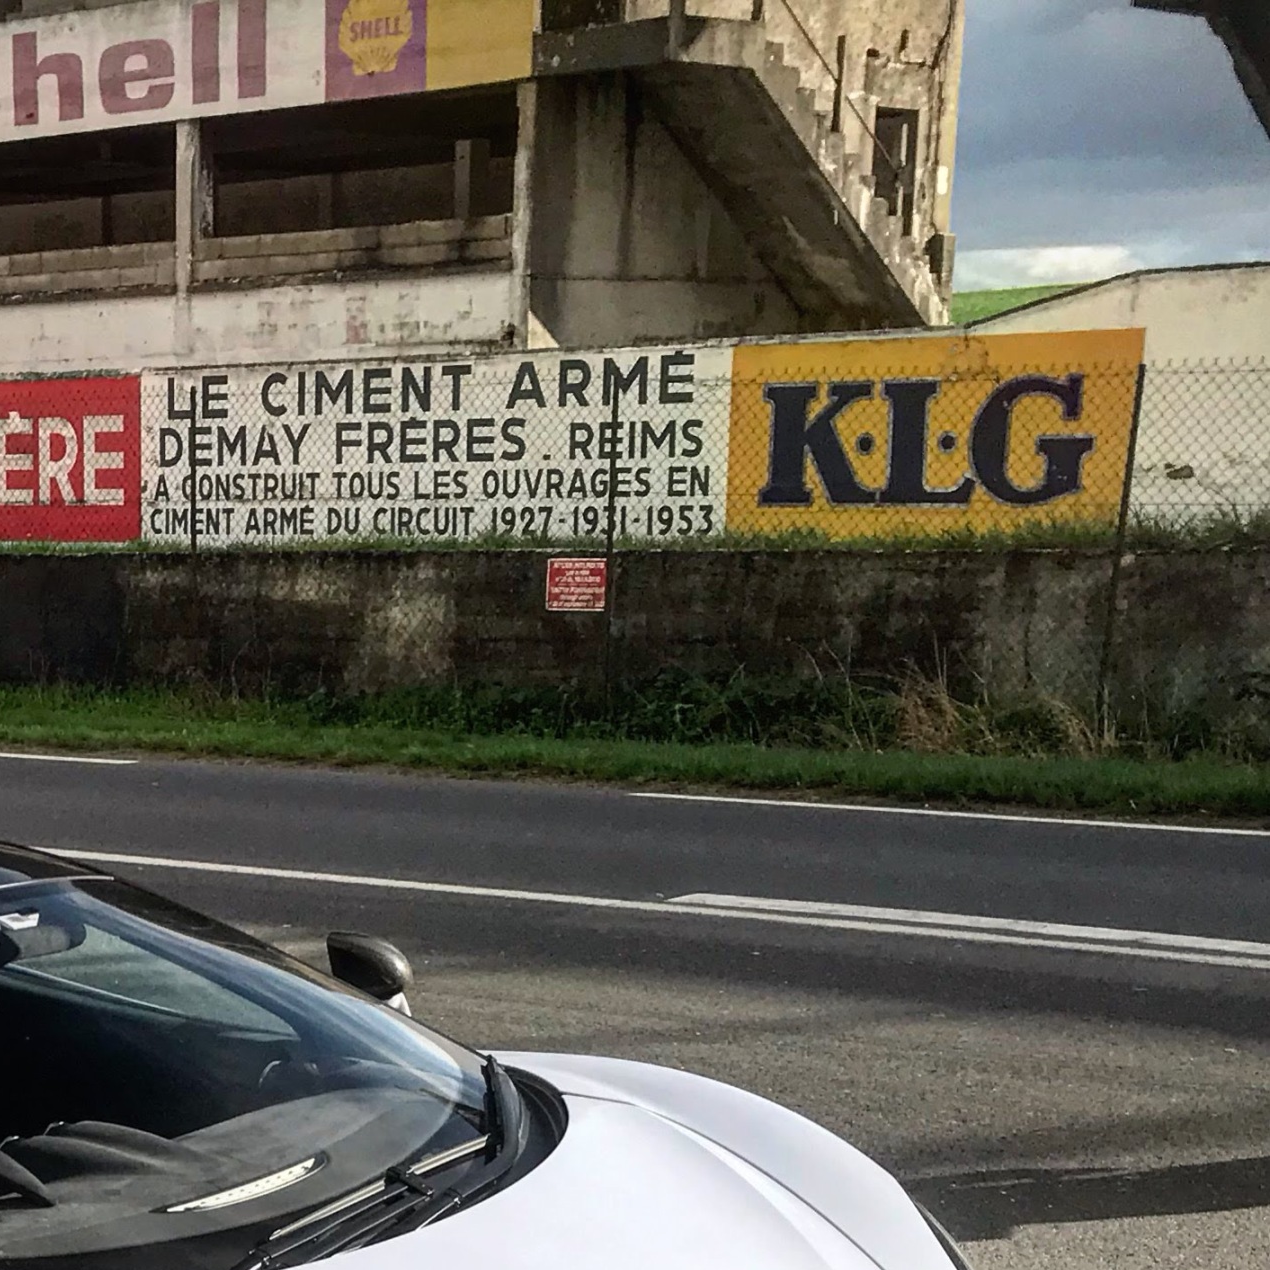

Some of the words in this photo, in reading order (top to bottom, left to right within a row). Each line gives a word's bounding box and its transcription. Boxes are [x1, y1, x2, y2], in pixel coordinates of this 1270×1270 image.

[349, 15, 404, 43] SHELL
[167, 374, 229, 420] LE
[260, 364, 472, 418] CIMENT
[505, 350, 696, 409] ARMÉ
[158, 422, 312, 468] DEMAY
[569, 419, 703, 460] REIMS
[154, 474, 170, 501] A
[181, 472, 320, 500] CONSTRUIT
[332, 471, 400, 500] TOUS
[414, 470, 468, 499] LES
[482, 466, 652, 499] OUVRAGES
[667, 465, 710, 497] EN
[150, 507, 234, 535] CIMENT
[327, 507, 360, 535] DU
[372, 506, 475, 536] CIRCUIT
